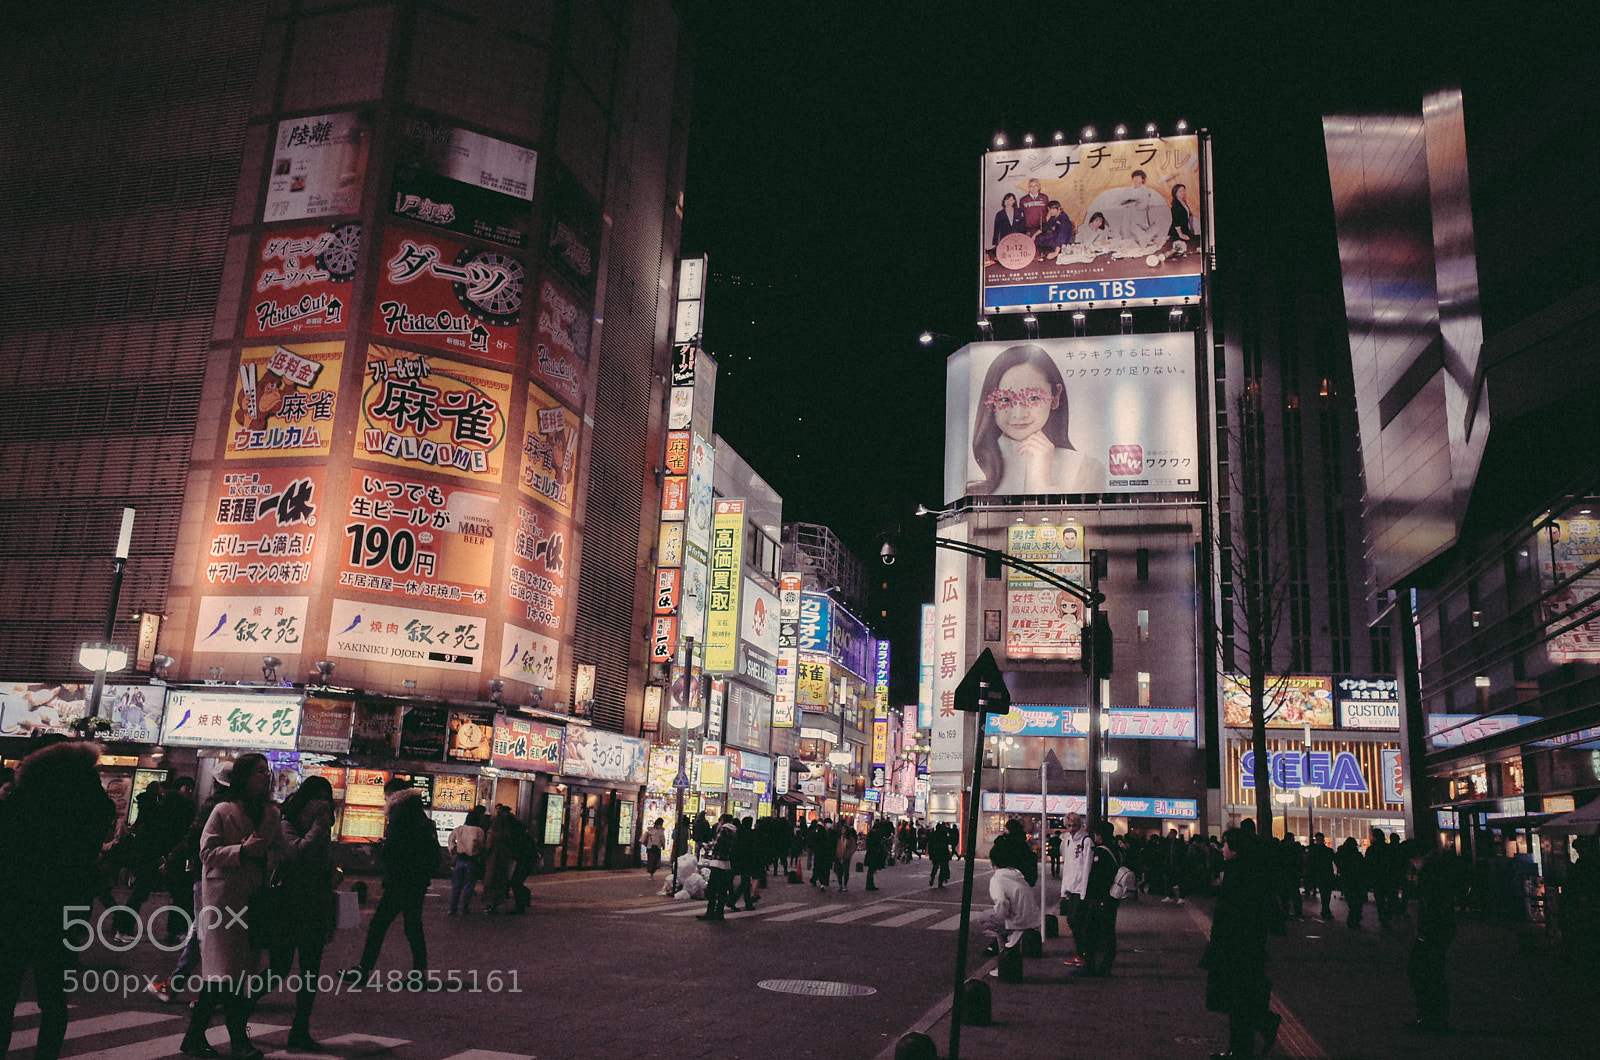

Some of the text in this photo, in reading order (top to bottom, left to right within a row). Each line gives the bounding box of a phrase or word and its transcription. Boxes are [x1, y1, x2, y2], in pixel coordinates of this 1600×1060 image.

[996, 145, 1191, 181] アンナチュラル
[266, 235, 331, 257] ダイニング
[262, 269, 327, 288] ダーツバー
[389, 242, 507, 299] ダーツ
[1048, 279, 1137, 302] From TBS
[1066, 347, 1171, 360] キラキラするには、
[272, 351, 313, 383] 低料金
[1066, 365, 1186, 379] ワクワクが足りない。
[278, 390, 335, 421] 麻雀
[373, 381, 495, 445] 麻雀
[233, 427, 320, 449] ウェルカム
[368, 430, 487, 469] WELCOME
[668, 440, 689, 469] 麻雀
[1146, 458, 1191, 468] ワクワク
[364, 478, 444, 506] いつでも
[352, 498, 452, 528] 生ビールが
[463, 538, 485, 546] BEER
[1011, 541, 1062, 551] 高収入求人
[1012, 530, 1036, 540] 男性
[712, 529, 736, 611] 高価買取
[1011, 605, 1059, 614] 高収入求人
[1012, 593, 1035, 603] 女性
[253, 606, 284, 616] 焼肉
[234, 616, 299, 644] 叙々苑
[369, 619, 480, 650] 焼肉 叙々苑
[337, 641, 426, 660] YAKINIKU JOJOEN
[940, 576, 959, 718] 広告募集
[197, 707, 295, 737] 焼肉 叙々苑
[1347, 704, 1399, 717] CUSTOM
[1111, 712, 1190, 737] カラオケ
[437, 785, 475, 804] 麻雀
